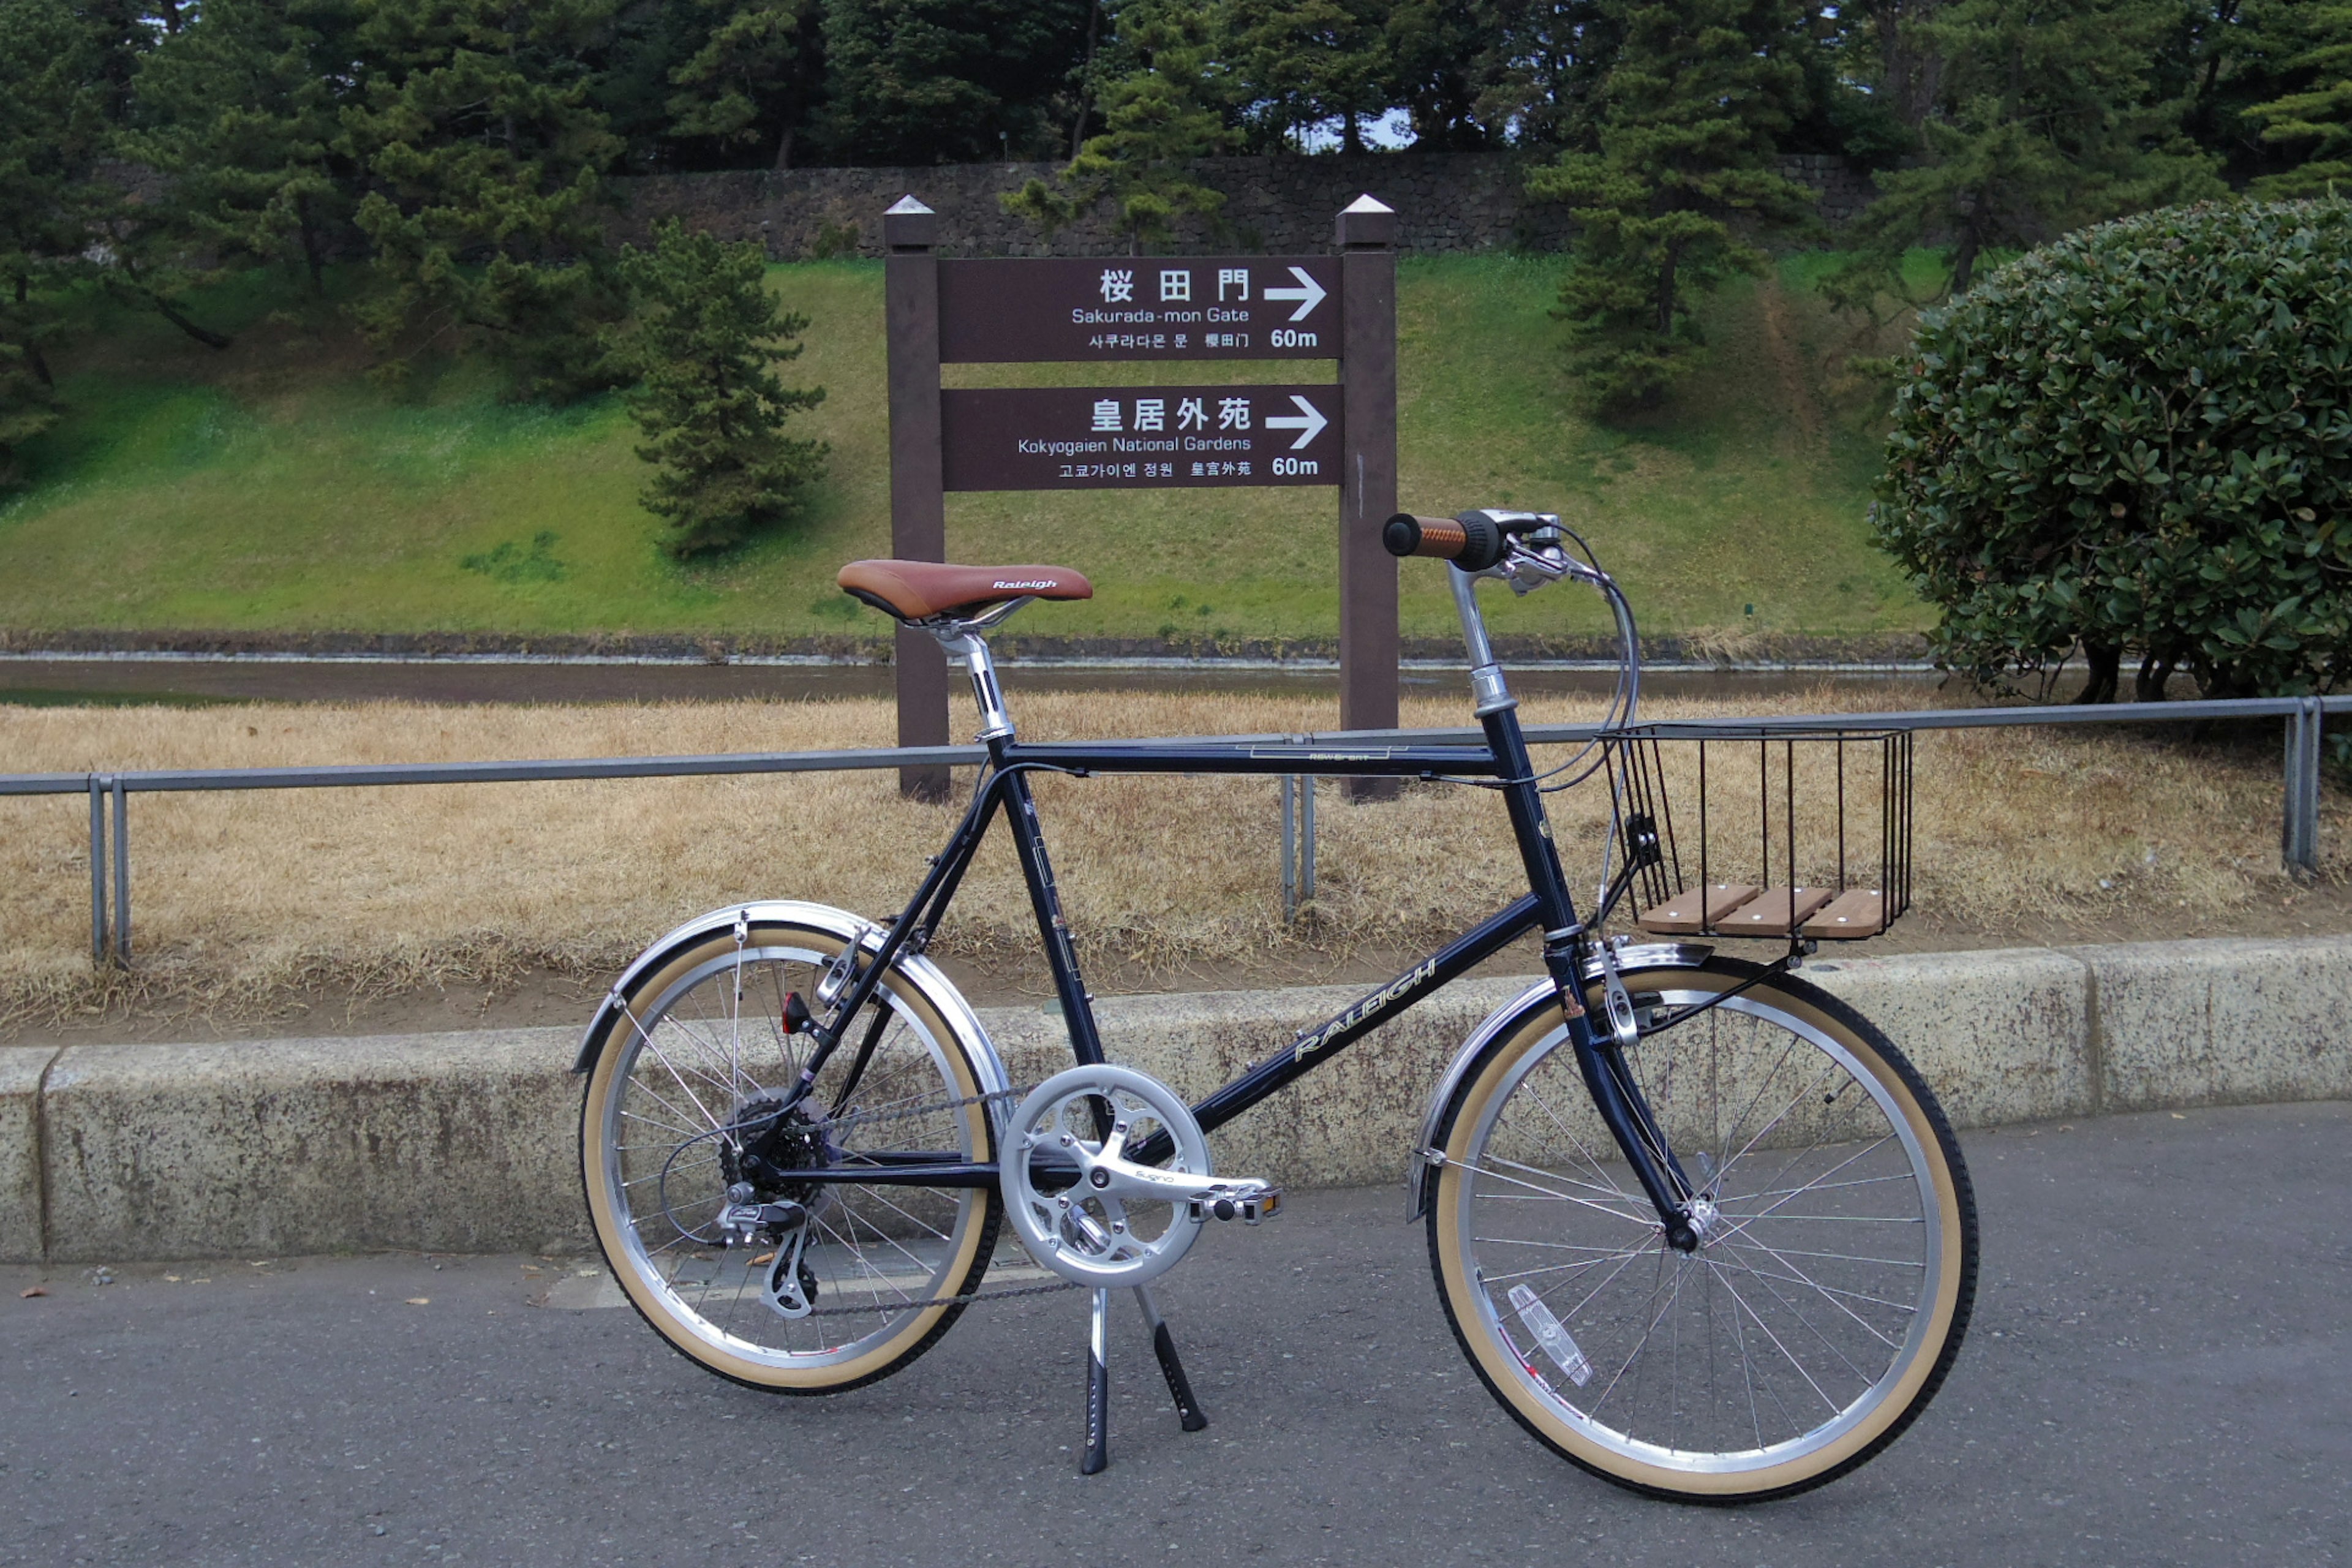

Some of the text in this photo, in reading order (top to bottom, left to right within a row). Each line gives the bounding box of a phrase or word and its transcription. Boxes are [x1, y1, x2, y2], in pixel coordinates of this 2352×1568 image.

[1100, 270, 1248, 302] 桜田門
[1072, 308, 1248, 323] Sakurada-mon Gate
[1174, 334, 1188, 349] 문
[1270, 329, 1317, 348] 60m
[1091, 398, 1251, 431] 皇居外苑
[1019, 436, 1251, 456] Kokyogaien National Gardens
[1059, 462, 1172, 478] 고쿄가이엔 정원
[1272, 457, 1318, 476] 60m
[993, 580, 1057, 589] Raleigh
[1295, 958, 1435, 1063] RALEIGH
